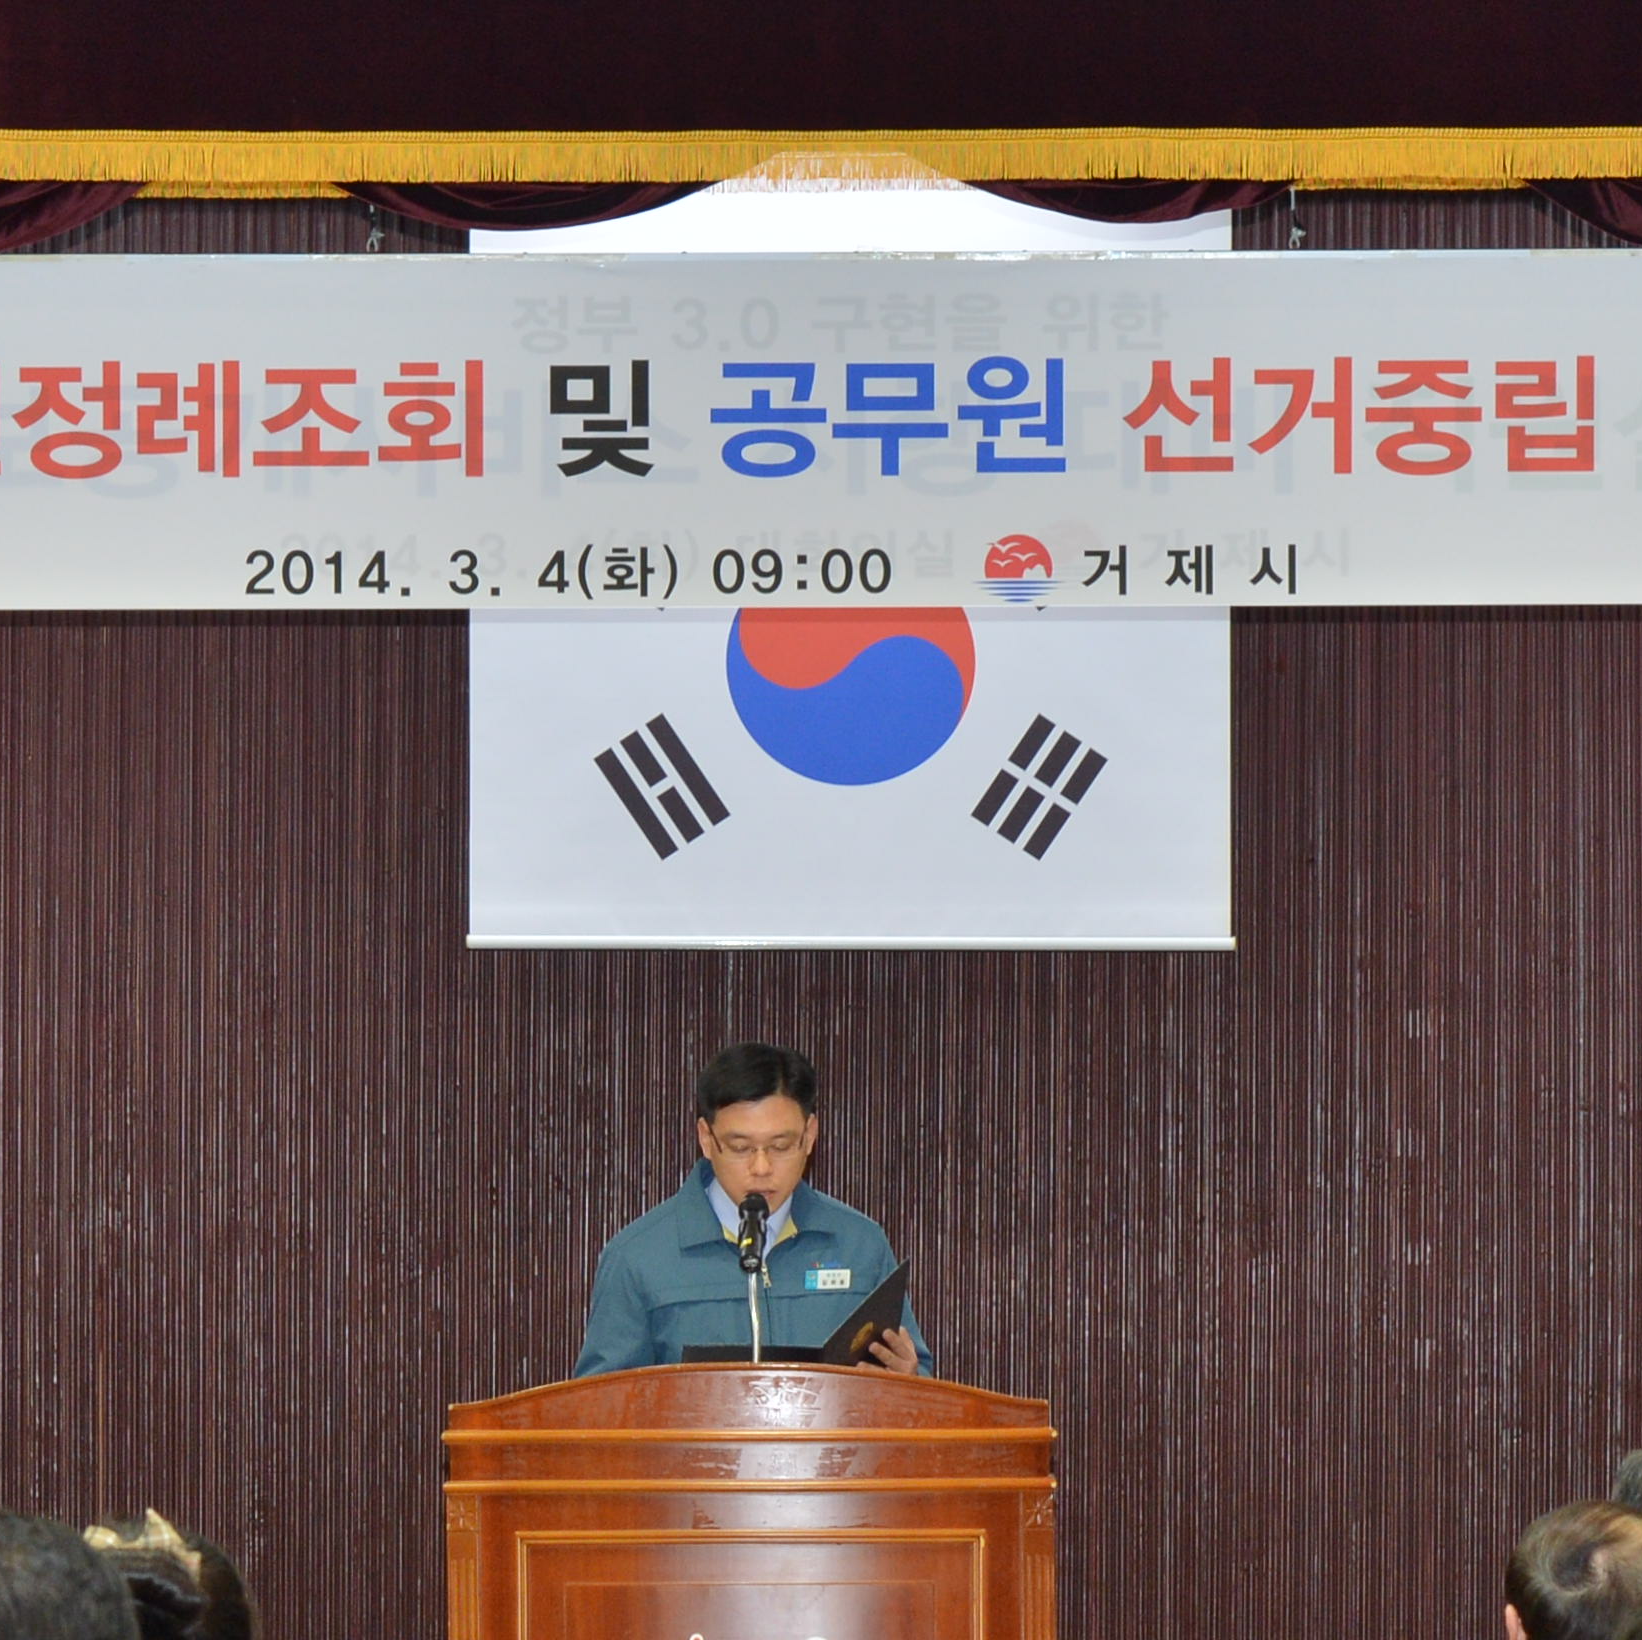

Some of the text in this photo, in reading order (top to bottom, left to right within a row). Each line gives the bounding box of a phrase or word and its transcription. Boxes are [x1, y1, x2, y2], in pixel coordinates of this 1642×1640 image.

[548, 358, 655, 478] 및
[709, 355, 1067, 479] 공무원
[1124, 355, 1595, 476] 선거중립
[245, 549, 411, 598] 2014.
[448, 548, 501, 597] 3.
[537, 543, 679, 600] 4(화)
[711, 547, 893, 595] 09:00
